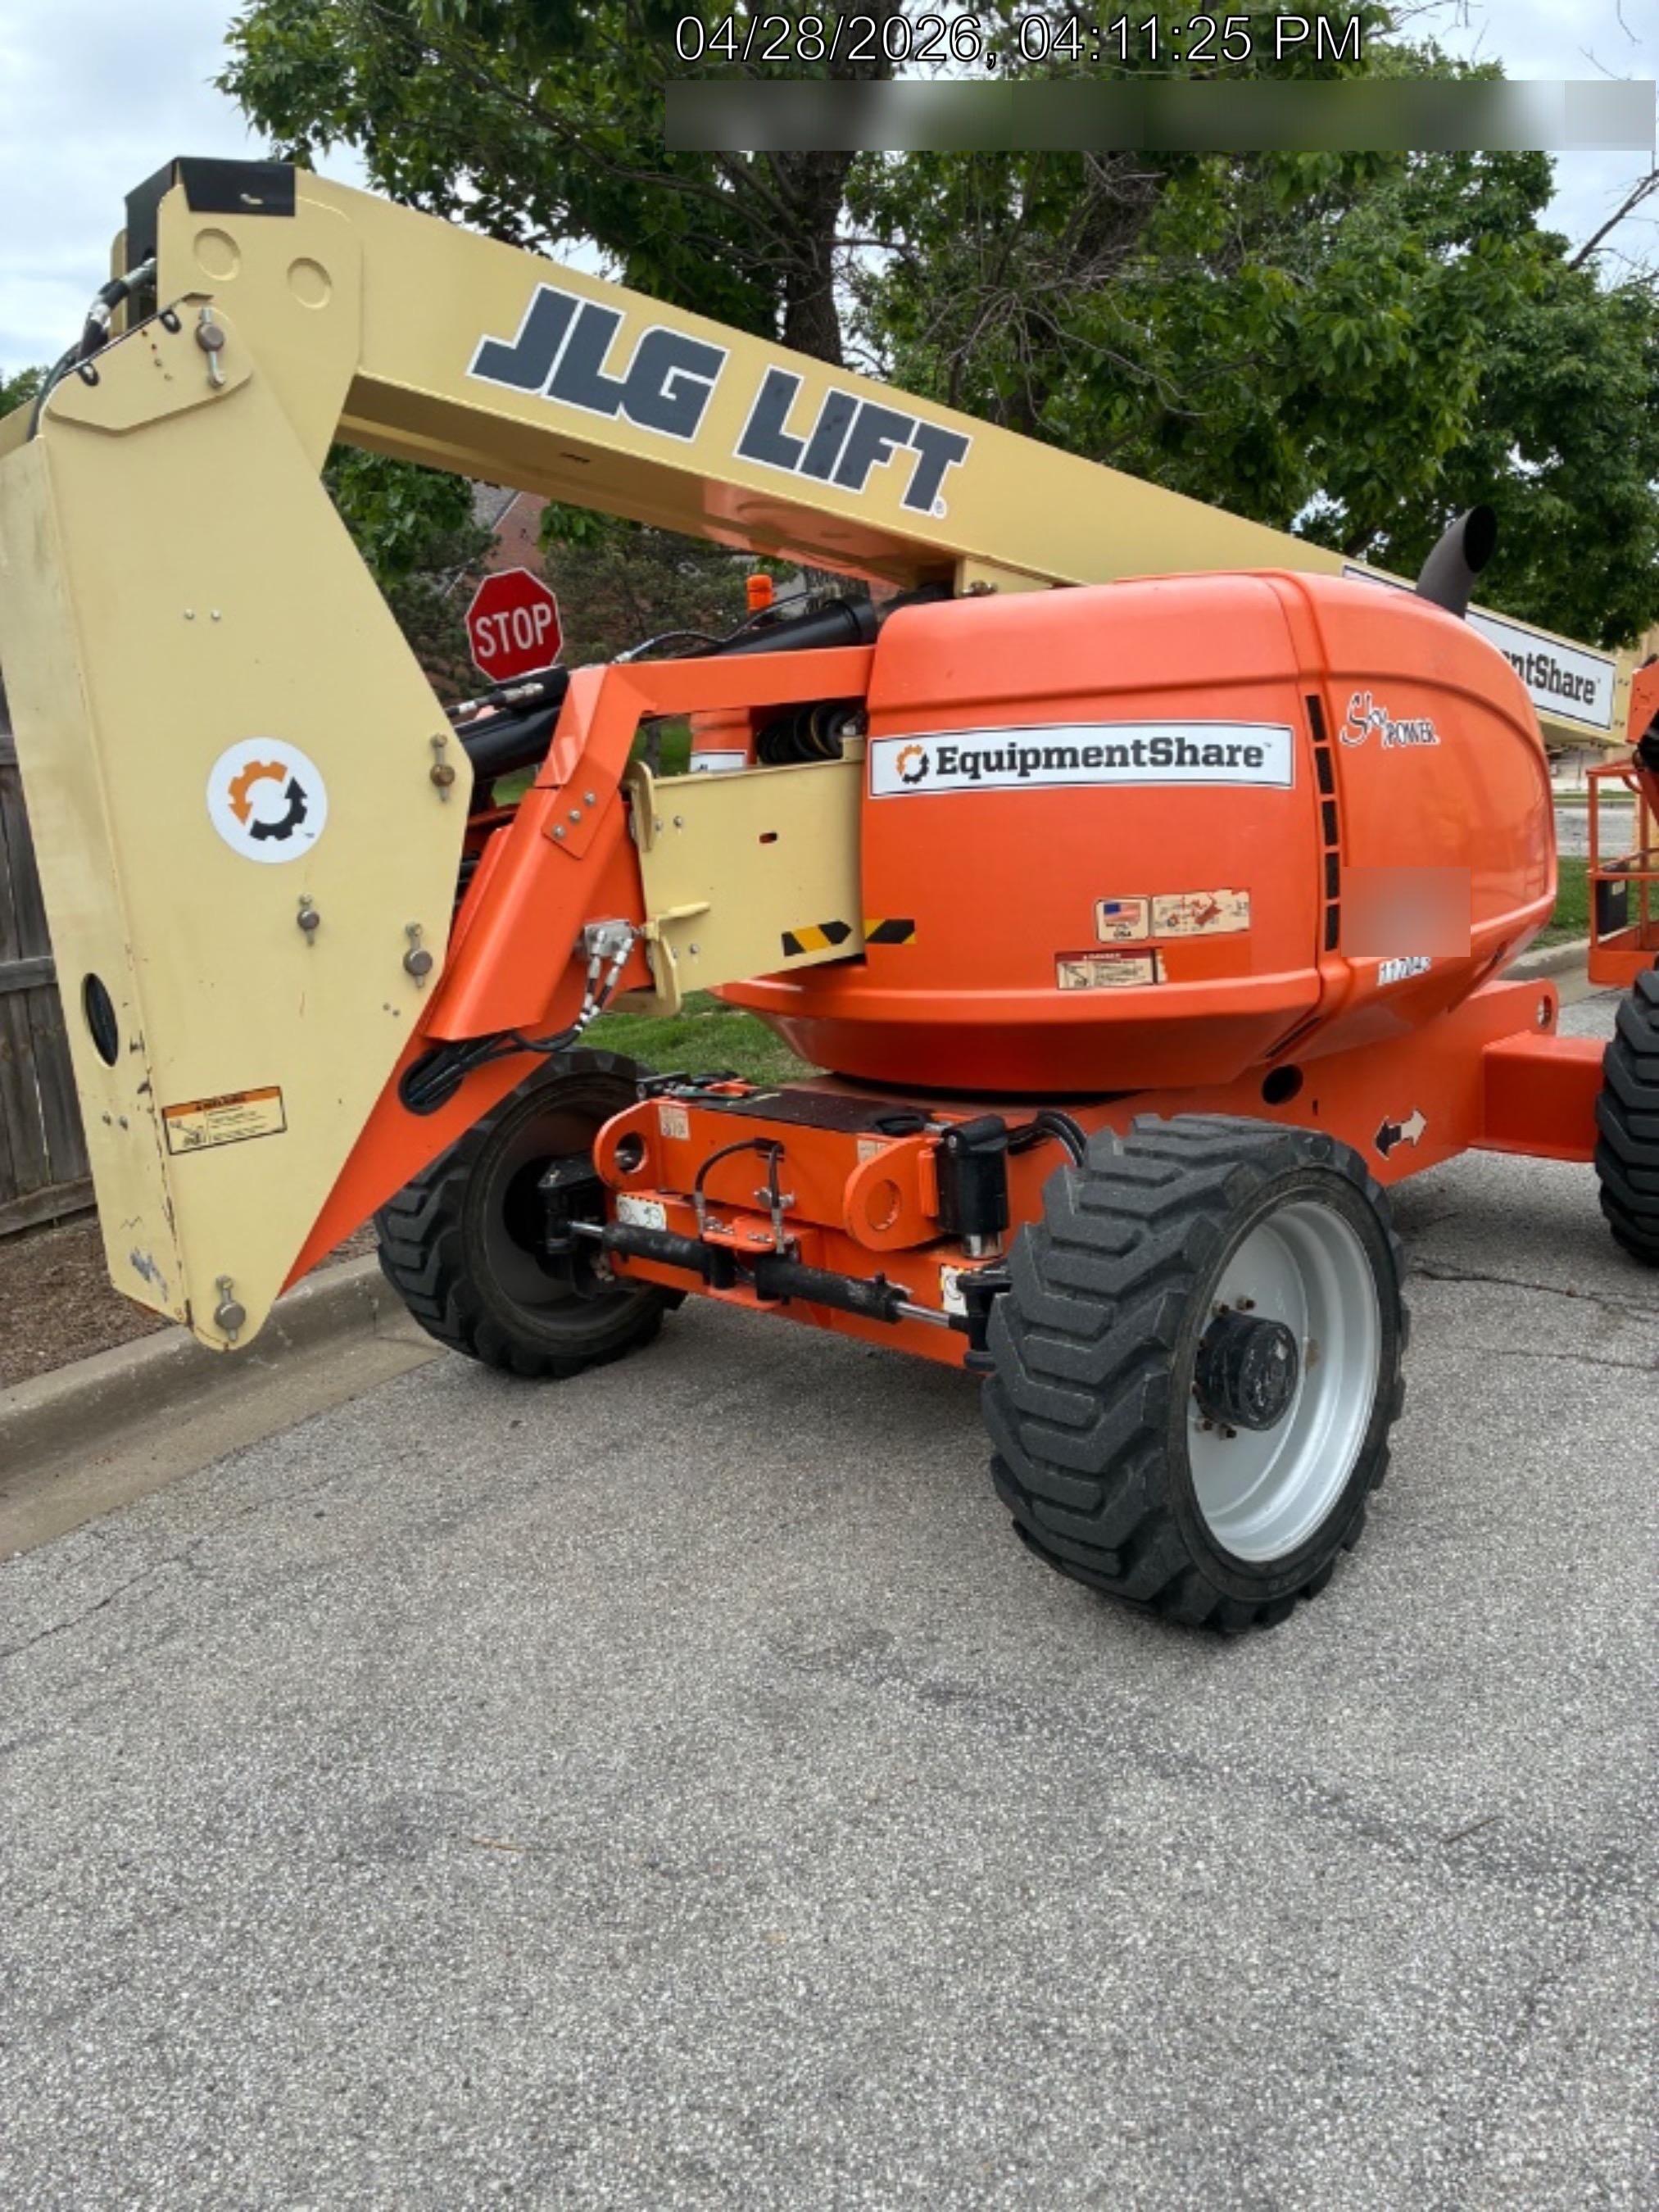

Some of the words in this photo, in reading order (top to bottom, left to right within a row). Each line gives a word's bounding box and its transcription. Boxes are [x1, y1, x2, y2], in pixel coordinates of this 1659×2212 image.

[465, 282, 731, 443] JLG
[475, 602, 552, 658] STOP
[936, 737, 1264, 780] EquipmentShare
